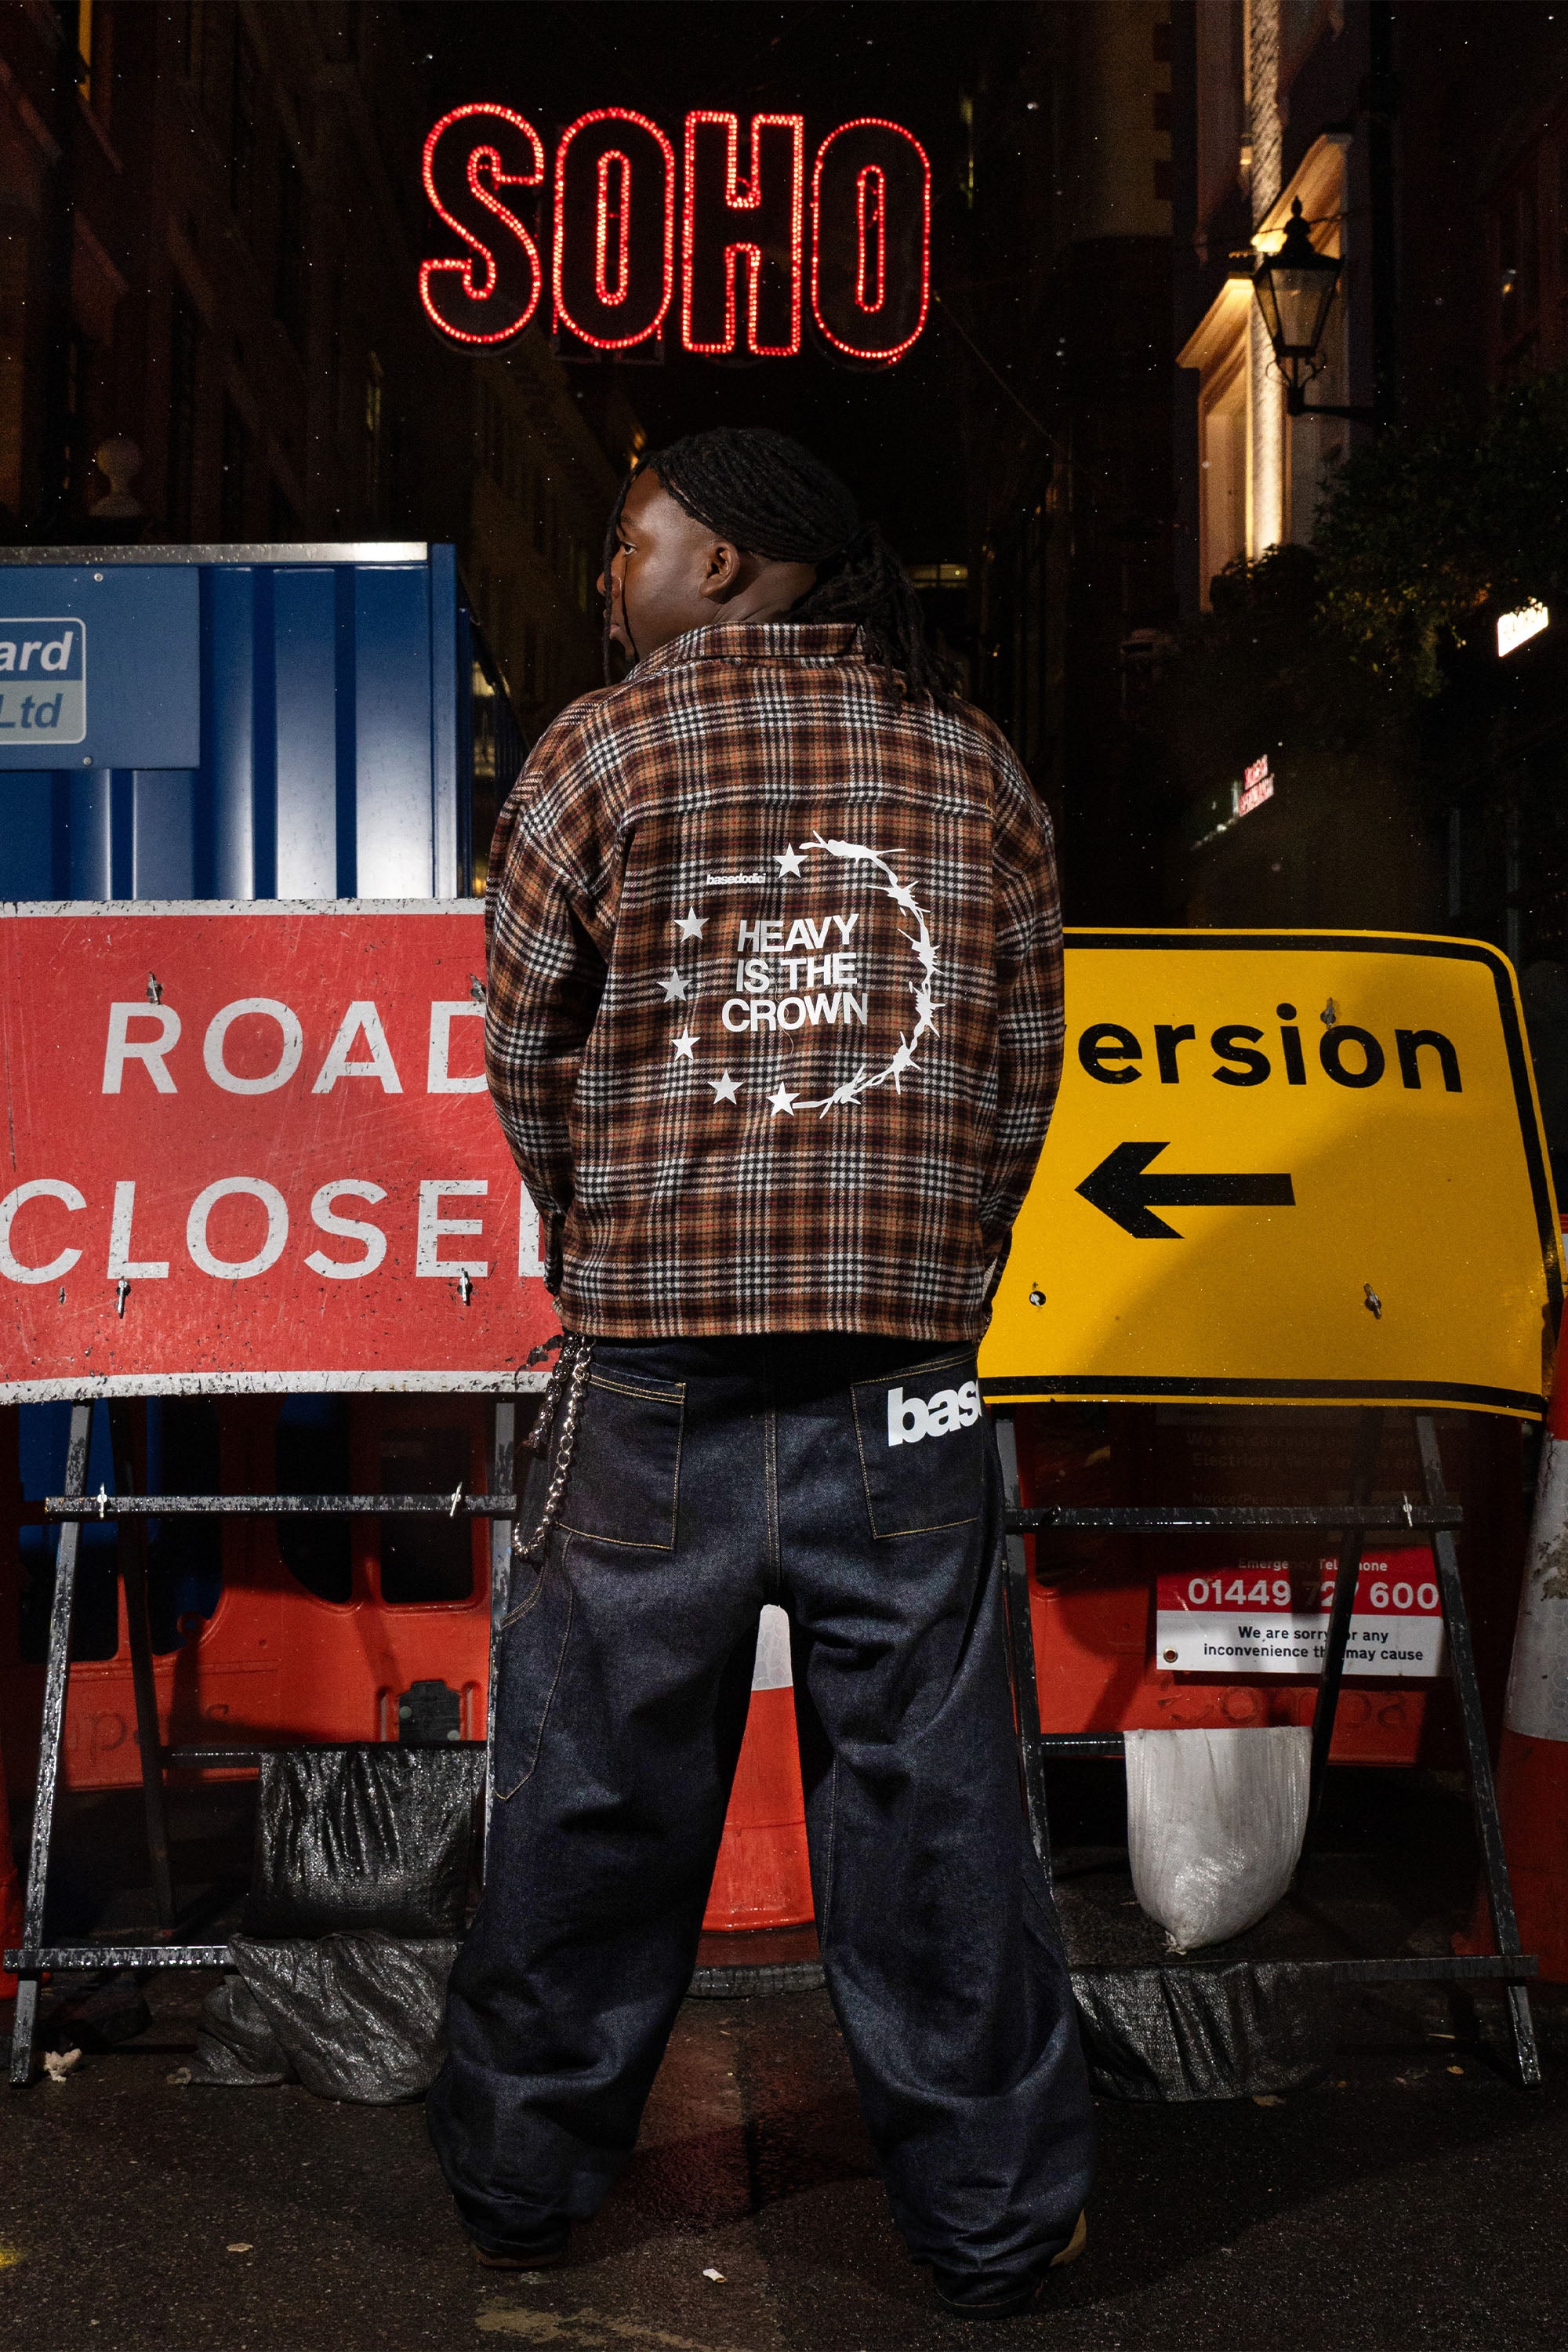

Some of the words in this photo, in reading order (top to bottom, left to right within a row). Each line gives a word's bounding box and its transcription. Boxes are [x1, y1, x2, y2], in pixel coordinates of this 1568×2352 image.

[419, 103, 931, 358] SOHO
[0, 631, 74, 671] ard
[0, 693, 64, 728] Ltd
[737, 913, 860, 953] HEAVY
[735, 958, 770, 993] IS
[781, 952, 858, 991] THE
[721, 992, 868, 1033] CROWN
[102, 997, 489, 1094] ROAD
[1064, 1003, 1463, 1093] ersion
[887, 1381, 982, 1446] bas
[1188, 1578, 1291, 1606] 01449
[1301, 1581, 1359, 1609] 72
[1370, 1582, 1439, 1609] 600
[1203, 1643, 1309, 1658] inconvenience
[1345, 1649, 1376, 1662] may
[1380, 1650, 1424, 1661] cause
[1238, 1626, 1261, 1639] We
[1266, 1629, 1289, 1639] are
[1363, 1632, 1388, 1644] any
